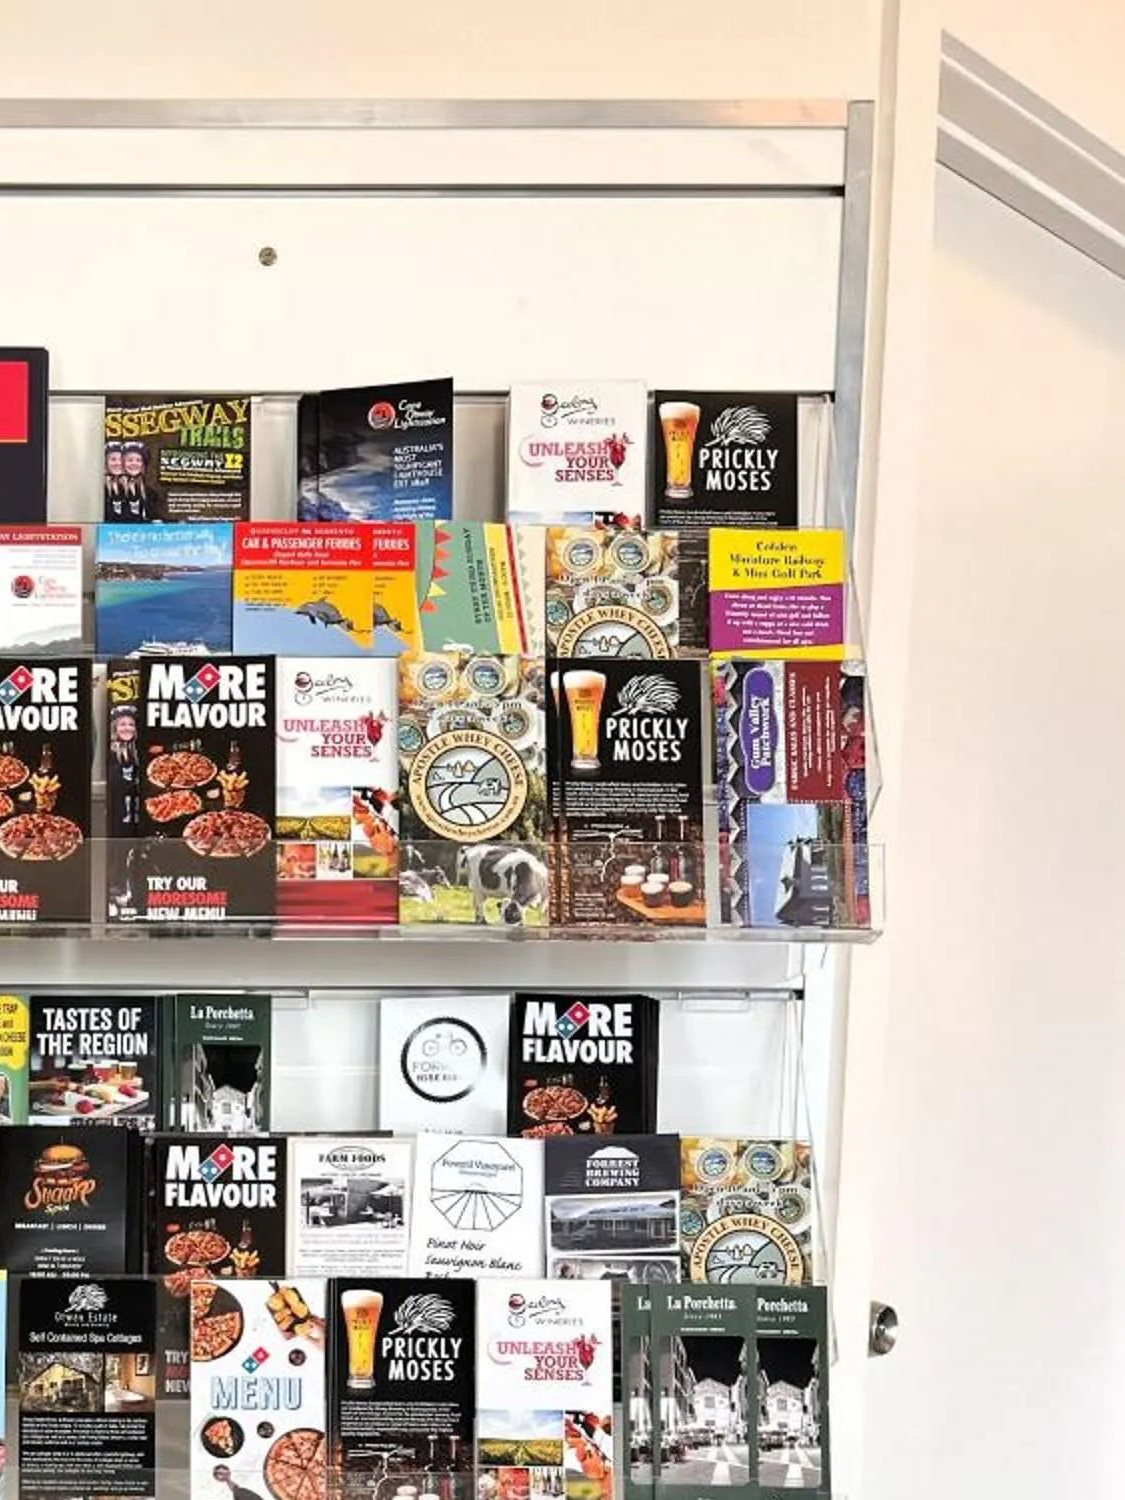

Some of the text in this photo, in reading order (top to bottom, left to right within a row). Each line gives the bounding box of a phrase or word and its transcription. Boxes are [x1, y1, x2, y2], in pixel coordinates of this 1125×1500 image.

[180, 425, 244, 449] TRAILS
[529, 441, 611, 456] UNLEASH
[566, 456, 611, 469] YOUR
[699, 449, 779, 469] PRICKLY
[555, 469, 614, 482] SENSES
[706, 469, 772, 491] MOSES
[242, 538, 260, 549] CAR
[271, 538, 323, 549] PASSENGER
[325, 539, 362, 550] FERRIES
[146, 702, 266, 729] FLAVOUR
[789, 709, 797, 729] AND
[282, 719, 366, 733] UNLEASH
[606, 717, 689, 740] PRICKLY
[749, 694, 763, 769] Gum Valley
[758, 697, 772, 767] Patchwork
[321, 733, 367, 745] YOUR
[452, 732, 491, 748] WHEY
[310, 745, 372, 758] SENSES
[613, 739, 682, 763] MOSES
[412, 735, 449, 785] APOSTLE
[147, 876, 207, 892] TRY OUR
[147, 907, 181, 920] NEW
[42, 1007, 142, 1031] TASTES OF
[190, 1004, 254, 1020] La Porchetta
[36, 1033, 148, 1056] THE REGION
[522, 1038, 633, 1064] FLAVOUR
[318, 1154, 386, 1164] FARM FOODS
[585, 1168, 640, 1178] BREWING
[584, 1177, 640, 1188] COMPANY
[164, 1183, 276, 1208] FLAVOUR
[730, 1217, 769, 1230] WHEY
[426, 1238, 487, 1252] Pinot Noir
[424, 1254, 524, 1273] Sauvignon Blanc
[667, 1296, 736, 1311] La Porchetta
[757, 1297, 809, 1313] Porchetta
[88, 1311, 118, 1323] Estate
[47, 1331, 88, 1343] Contained
[106, 1332, 142, 1345] Cottages
[382, 1337, 463, 1358] PRICKLY
[496, 1340, 577, 1356] UNLEASH
[533, 1355, 579, 1369] YOUR
[388, 1359, 455, 1382] MOSES
[523, 1368, 585, 1382] SENSES
[210, 1376, 303, 1411] MENU
